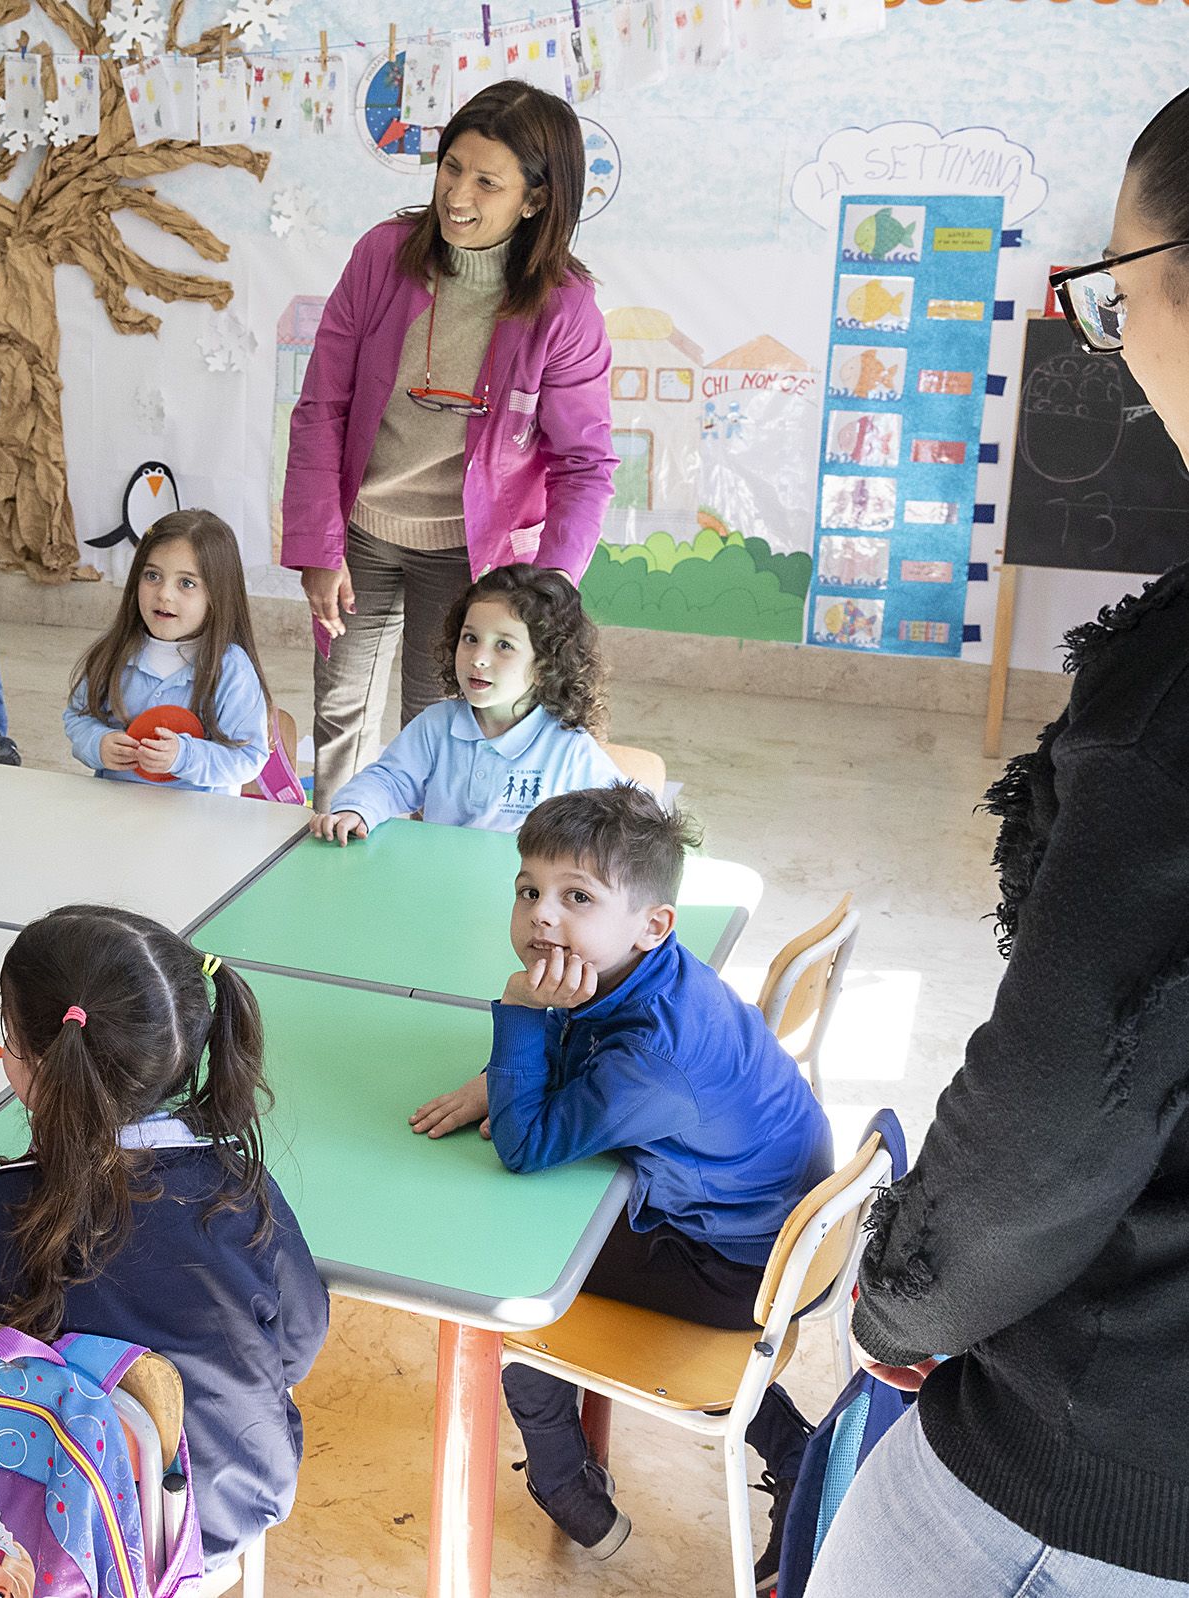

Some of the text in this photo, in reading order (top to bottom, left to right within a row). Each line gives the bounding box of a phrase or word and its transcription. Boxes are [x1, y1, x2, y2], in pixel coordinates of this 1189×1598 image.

[815, 143, 1022, 205] LA SETTIMANA
[701, 375, 729, 398] CHI
[740, 372, 778, 390] NON
